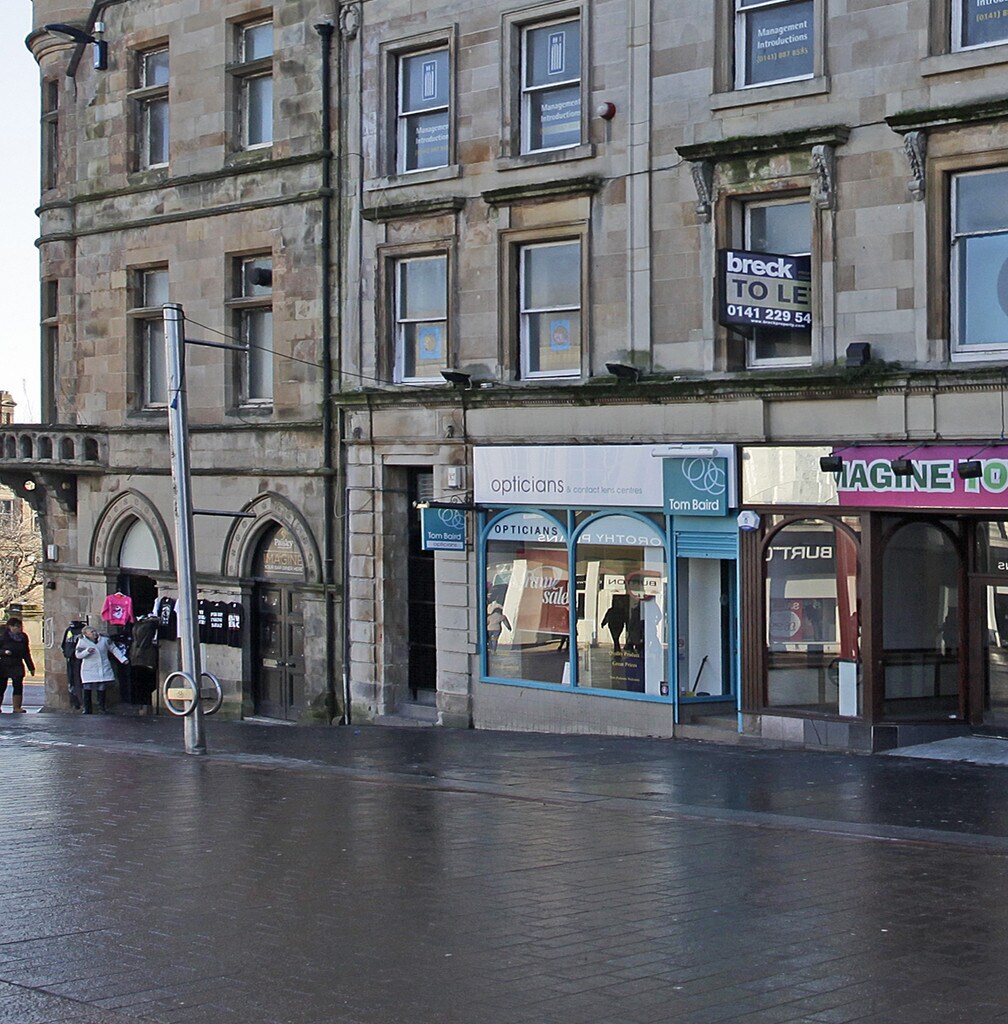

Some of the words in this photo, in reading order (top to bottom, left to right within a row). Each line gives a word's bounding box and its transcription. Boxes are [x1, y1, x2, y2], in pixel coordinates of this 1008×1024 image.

[757, 20, 808, 38] Management
[757, 33, 808, 50] Introductions
[727, 252, 793, 279] breck
[732, 279, 768, 301] TO
[777, 284, 811, 305] LE
[727, 305, 760, 318] 0141
[765, 309, 791, 322] 229
[491, 476, 564, 496] opticians
[573, 486, 599, 494] contact
[669, 498, 690, 510] Tom
[692, 499, 720, 511] Baird
[427, 532, 442, 540] Tom
[444, 532, 461, 540] Baird
[494, 525, 558, 535] OPTICIANS
[542, 587, 570, 605] sale
